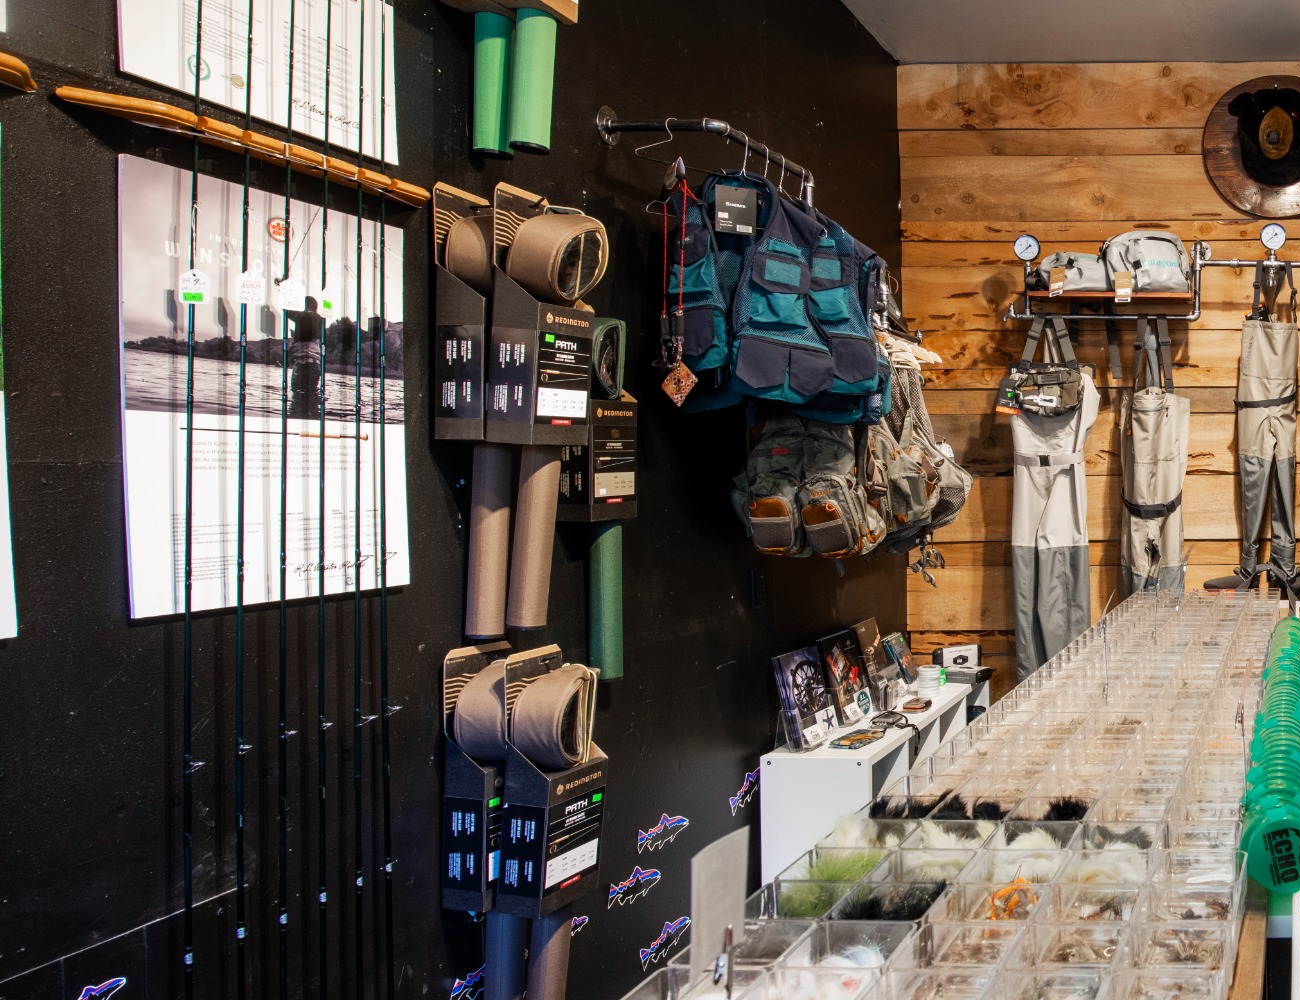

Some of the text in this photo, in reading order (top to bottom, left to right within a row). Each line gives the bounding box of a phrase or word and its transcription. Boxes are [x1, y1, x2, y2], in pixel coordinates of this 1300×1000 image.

[555, 316, 589, 328] REDINGTON
[555, 340, 577, 351] PATH
[565, 771, 602, 790] REDINGTON
[565, 799, 588, 814] PATH
[1271, 828, 1299, 883] ECHO
